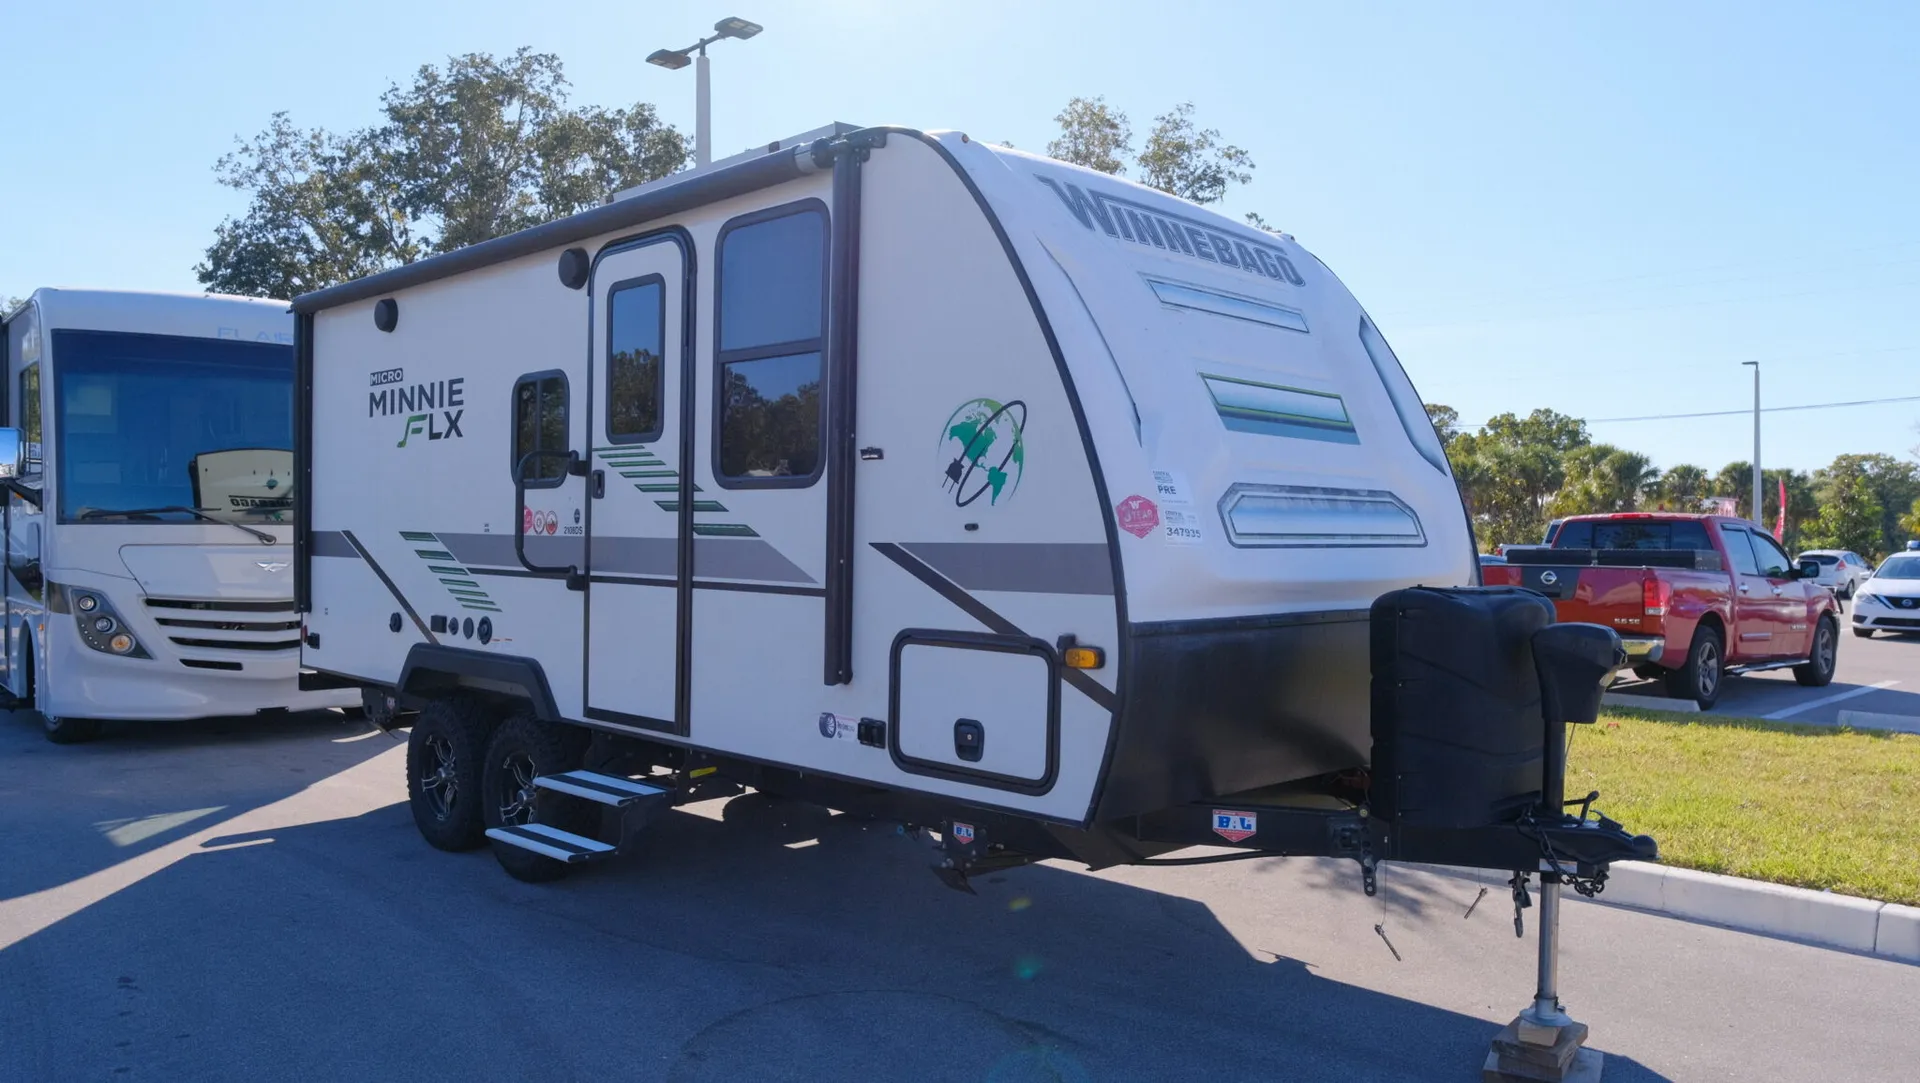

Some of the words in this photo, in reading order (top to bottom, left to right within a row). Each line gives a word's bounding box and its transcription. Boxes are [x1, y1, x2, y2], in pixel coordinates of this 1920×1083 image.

[1033, 173, 1306, 287] WINNEBAGO
[370, 368, 403, 386] MICRO
[369, 377, 465, 418] MINNIE
[397, 410, 464, 448] FLX
[1157, 485, 1177, 495] PRE
[1166, 527, 1202, 538] 347935
